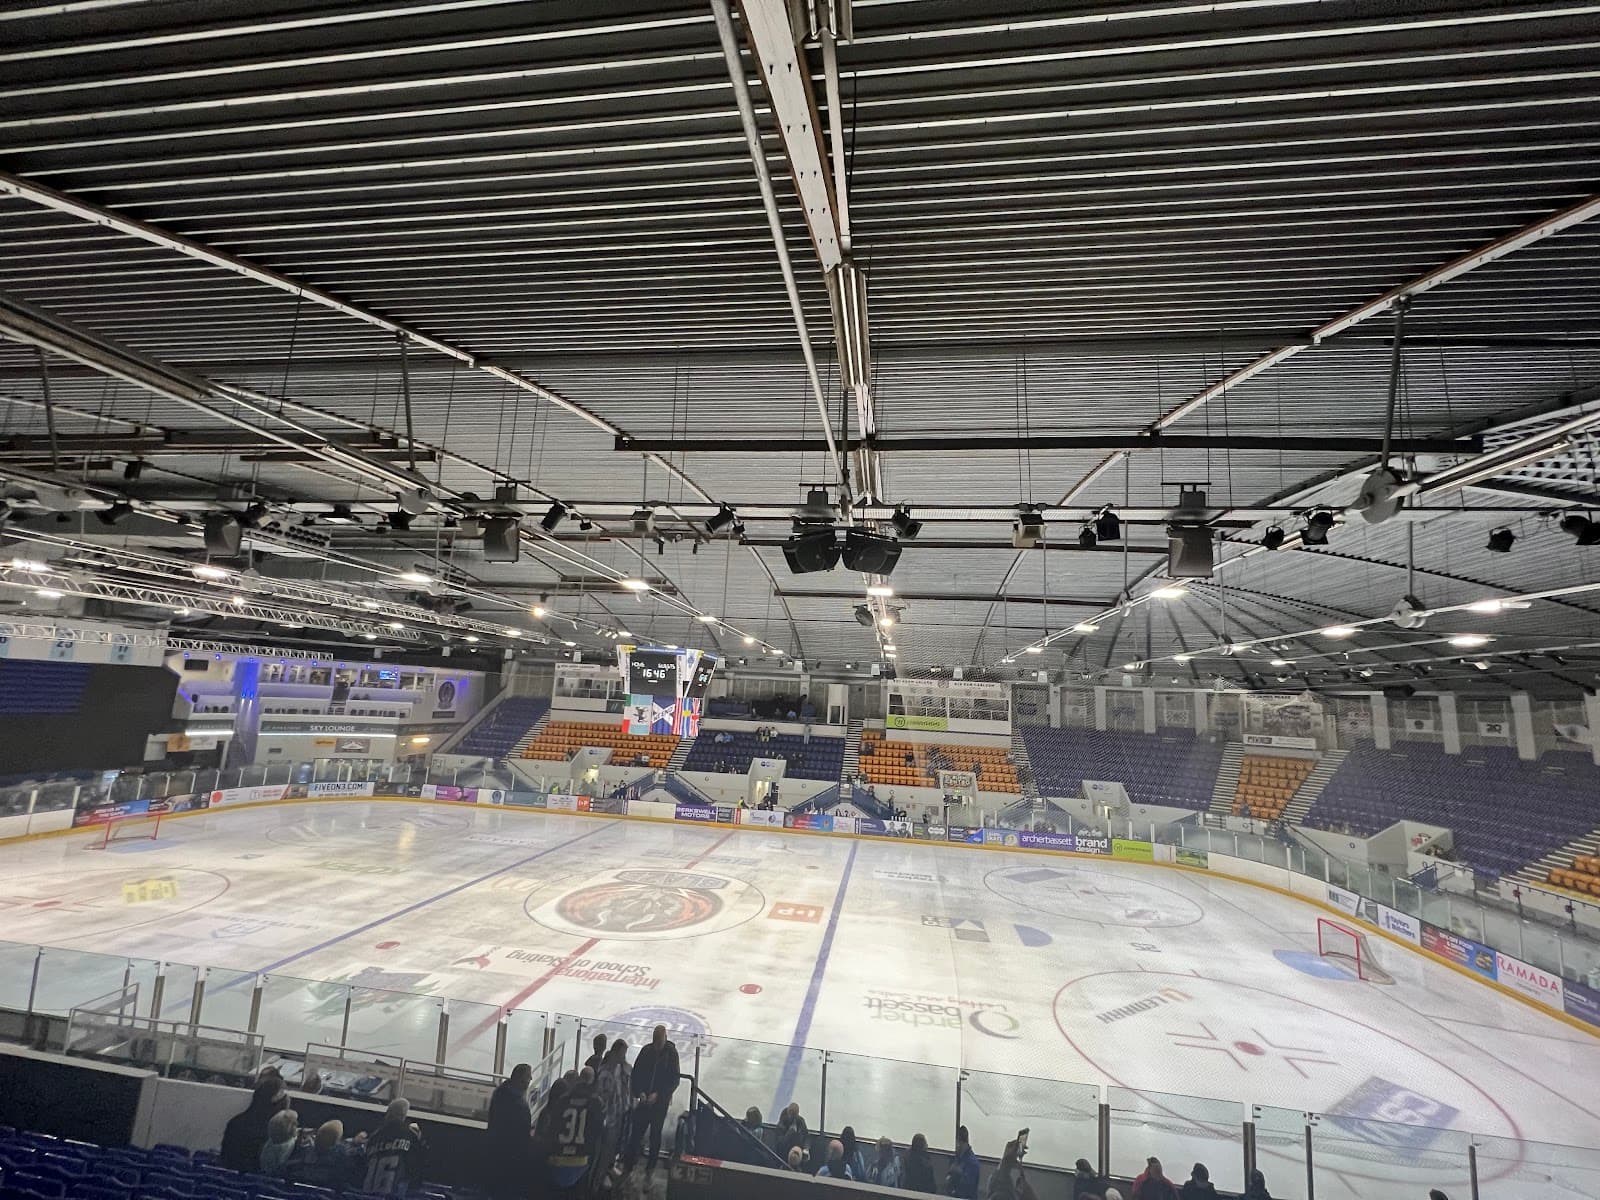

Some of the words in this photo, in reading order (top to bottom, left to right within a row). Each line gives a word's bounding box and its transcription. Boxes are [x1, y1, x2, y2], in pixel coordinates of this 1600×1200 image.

[676, 806, 716, 815] BERKSWELL
[1021, 835, 1073, 846] archerbassett
[1075, 836, 1107, 848] brand
[1075, 847, 1100, 855] design
[597, 961, 652, 977] School
[1497, 955, 1560, 993] RAMADA
[863, 996, 962, 1019] bassett
[870, 1008, 962, 1029] archer
[558, 1108, 587, 1144] 31
